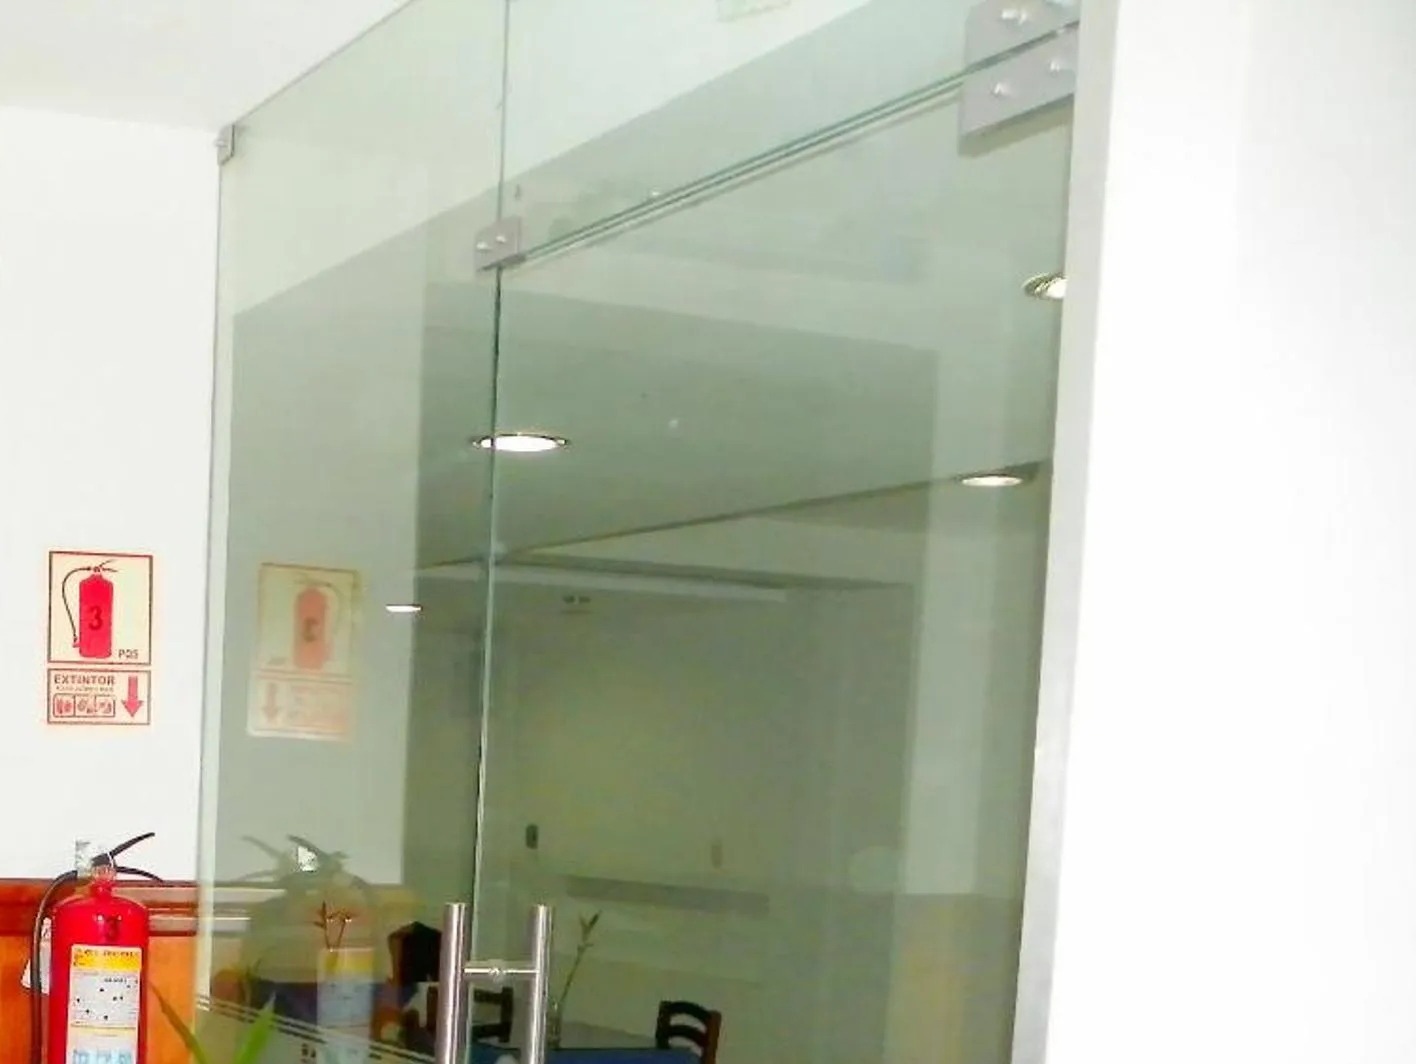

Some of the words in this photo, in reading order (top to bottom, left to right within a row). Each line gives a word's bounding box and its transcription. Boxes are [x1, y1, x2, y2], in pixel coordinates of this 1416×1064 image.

[88, 605, 103, 631] 3
[118, 649, 139, 659] PQS
[54, 673, 116, 685] EXTINTOR
